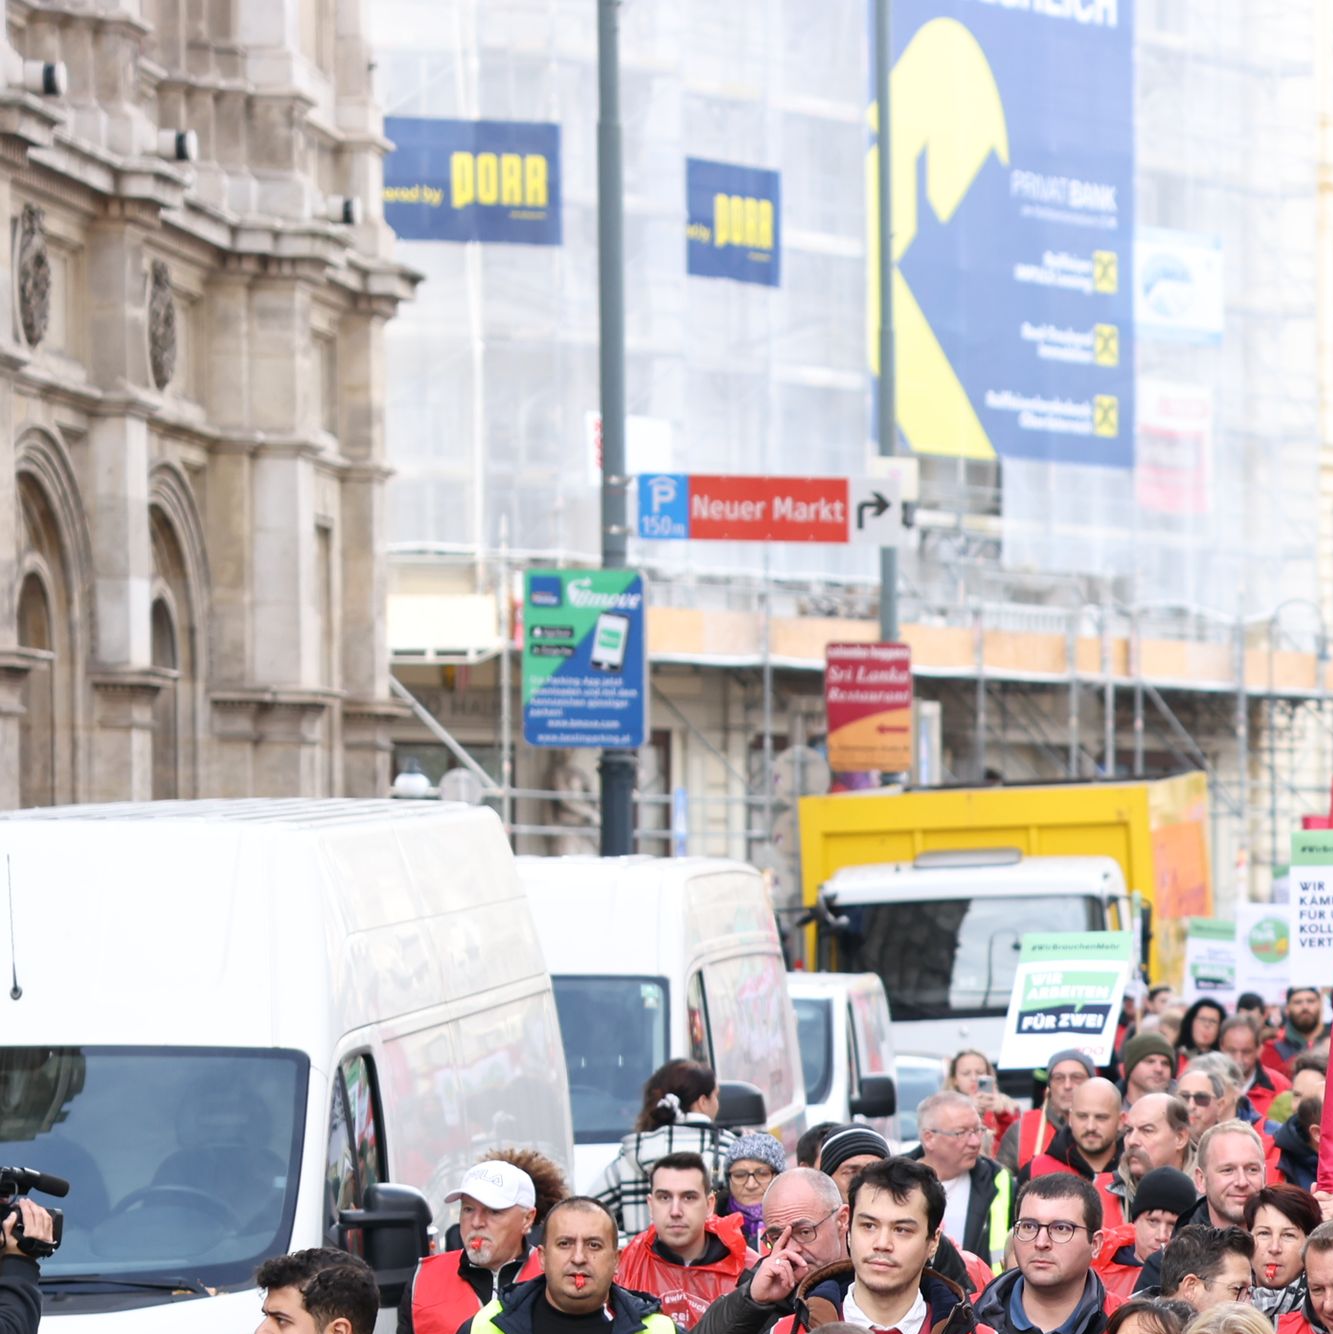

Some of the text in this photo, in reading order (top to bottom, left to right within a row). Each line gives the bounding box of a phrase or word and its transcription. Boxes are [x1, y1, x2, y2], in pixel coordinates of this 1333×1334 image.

[691, 494, 844, 523] Neuer Markt
[1300, 880, 1325, 892] WIR
[1021, 1011, 1105, 1031] FÜR ZWEI
[671, 1309, 690, 1322] sei
